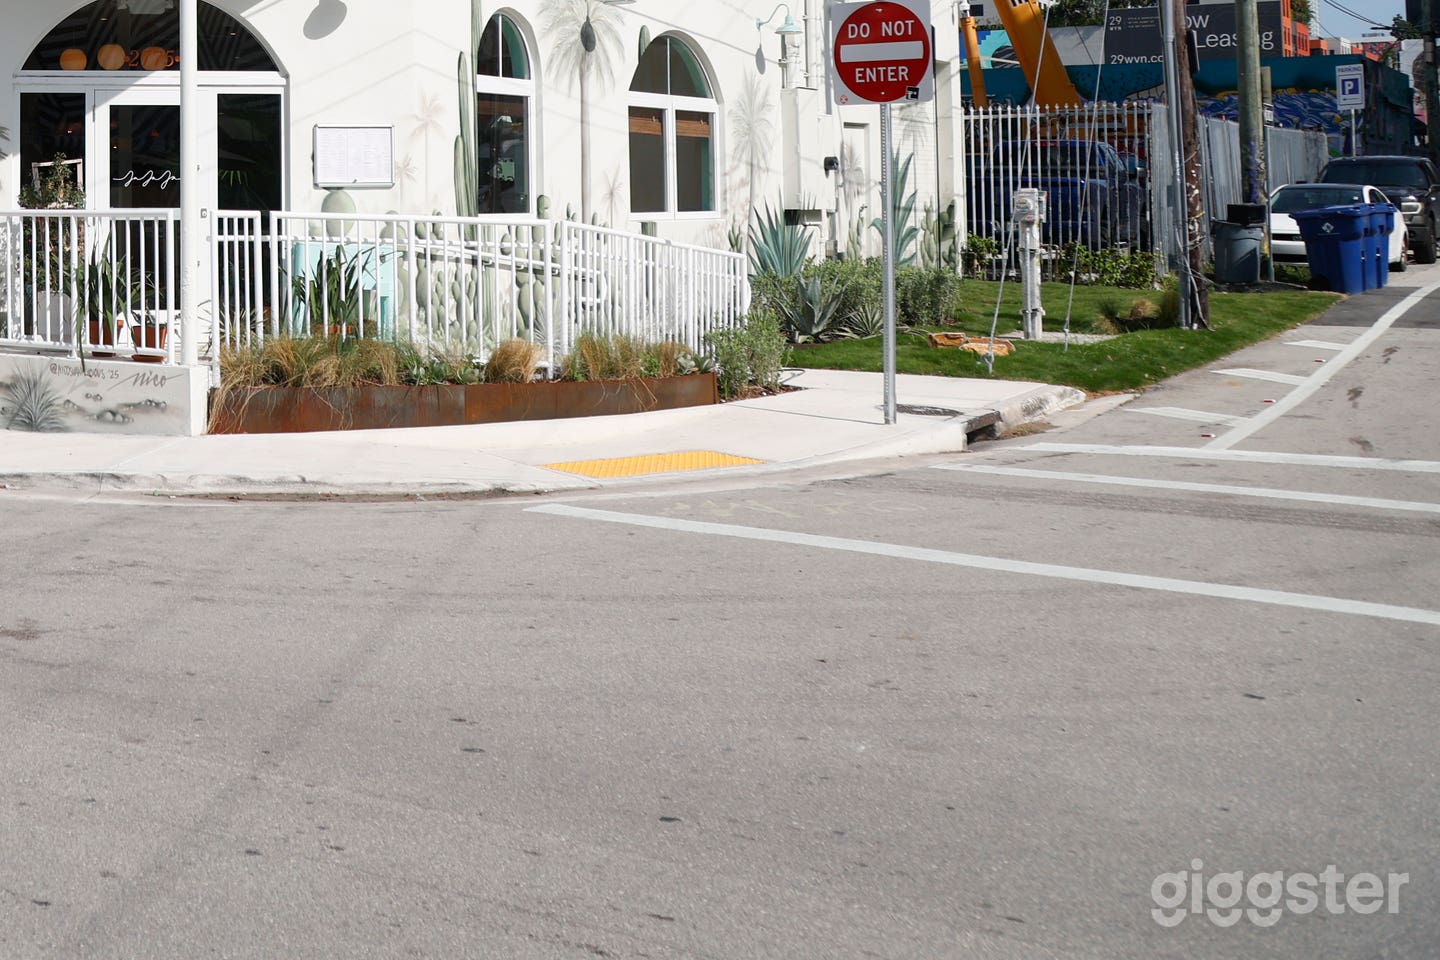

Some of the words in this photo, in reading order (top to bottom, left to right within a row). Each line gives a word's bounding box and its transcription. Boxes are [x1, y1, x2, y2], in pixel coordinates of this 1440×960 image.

[1109, 15, 1122, 26] 29
[1185, 14, 1210, 29] ow
[847, 22, 870, 39] DO
[881, 19, 915, 37] NOT
[1195, 30, 1275, 51] Leasg
[855, 65, 909, 83] ENTER
[1337, 65, 1362, 73] PARKING
[1344, 80, 1354, 96] P
